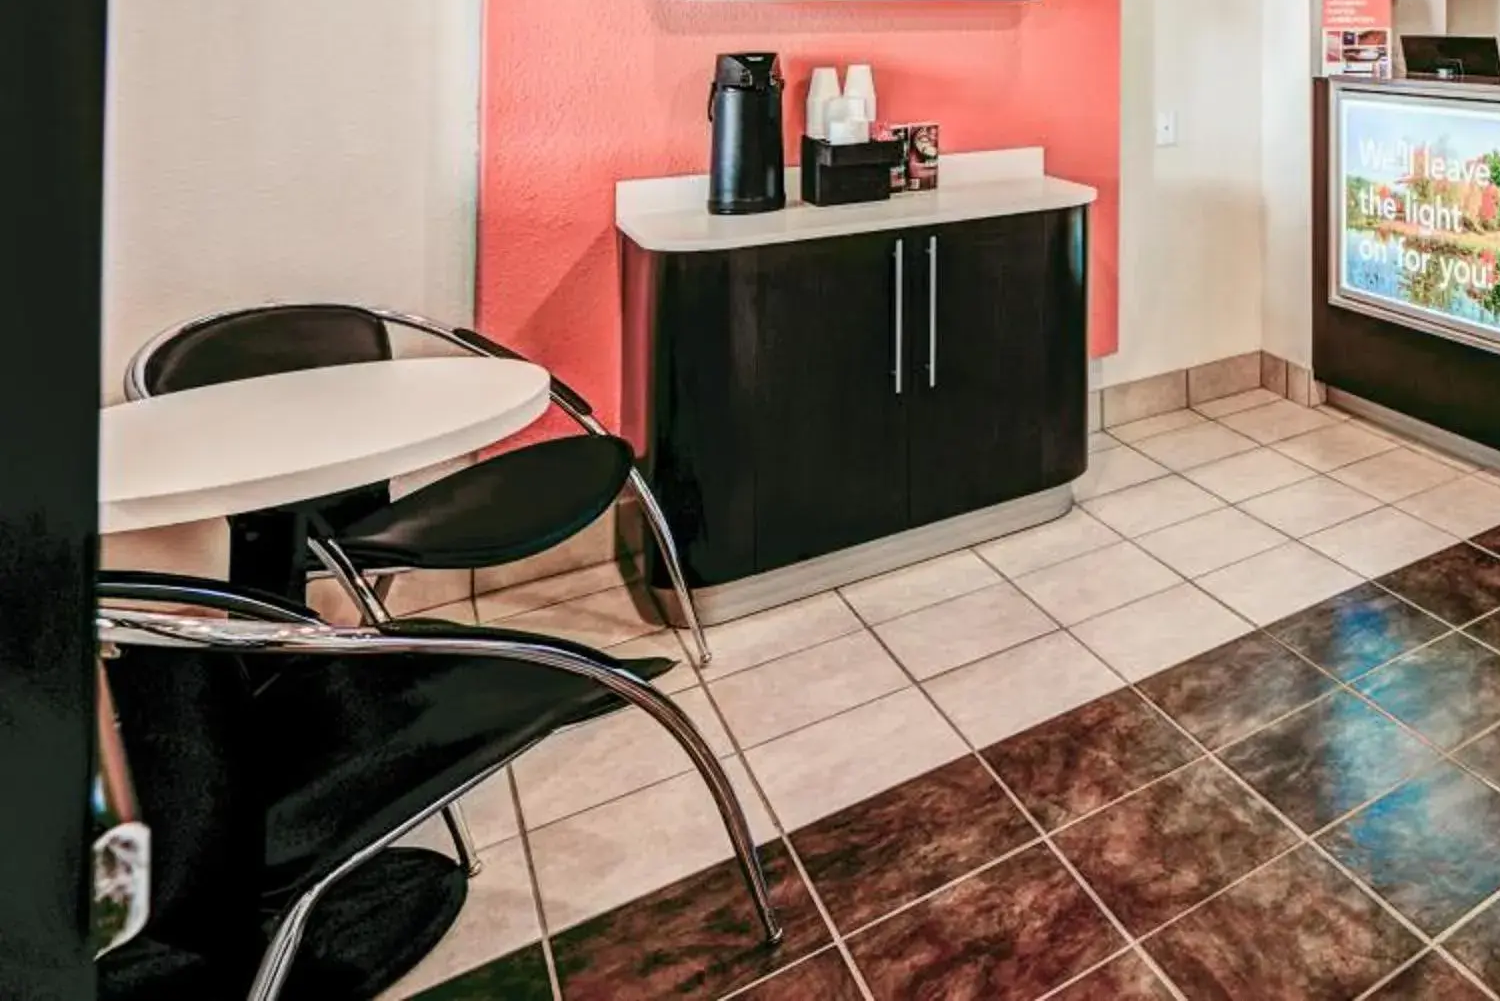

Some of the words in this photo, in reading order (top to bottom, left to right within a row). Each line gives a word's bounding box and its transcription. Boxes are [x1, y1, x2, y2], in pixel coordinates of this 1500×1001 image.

[1424, 143, 1491, 186] leave
[1358, 186, 1397, 220] the
[1405, 190, 1463, 235] light
[1359, 238, 1387, 263] on
[1390, 237, 1431, 274] for
